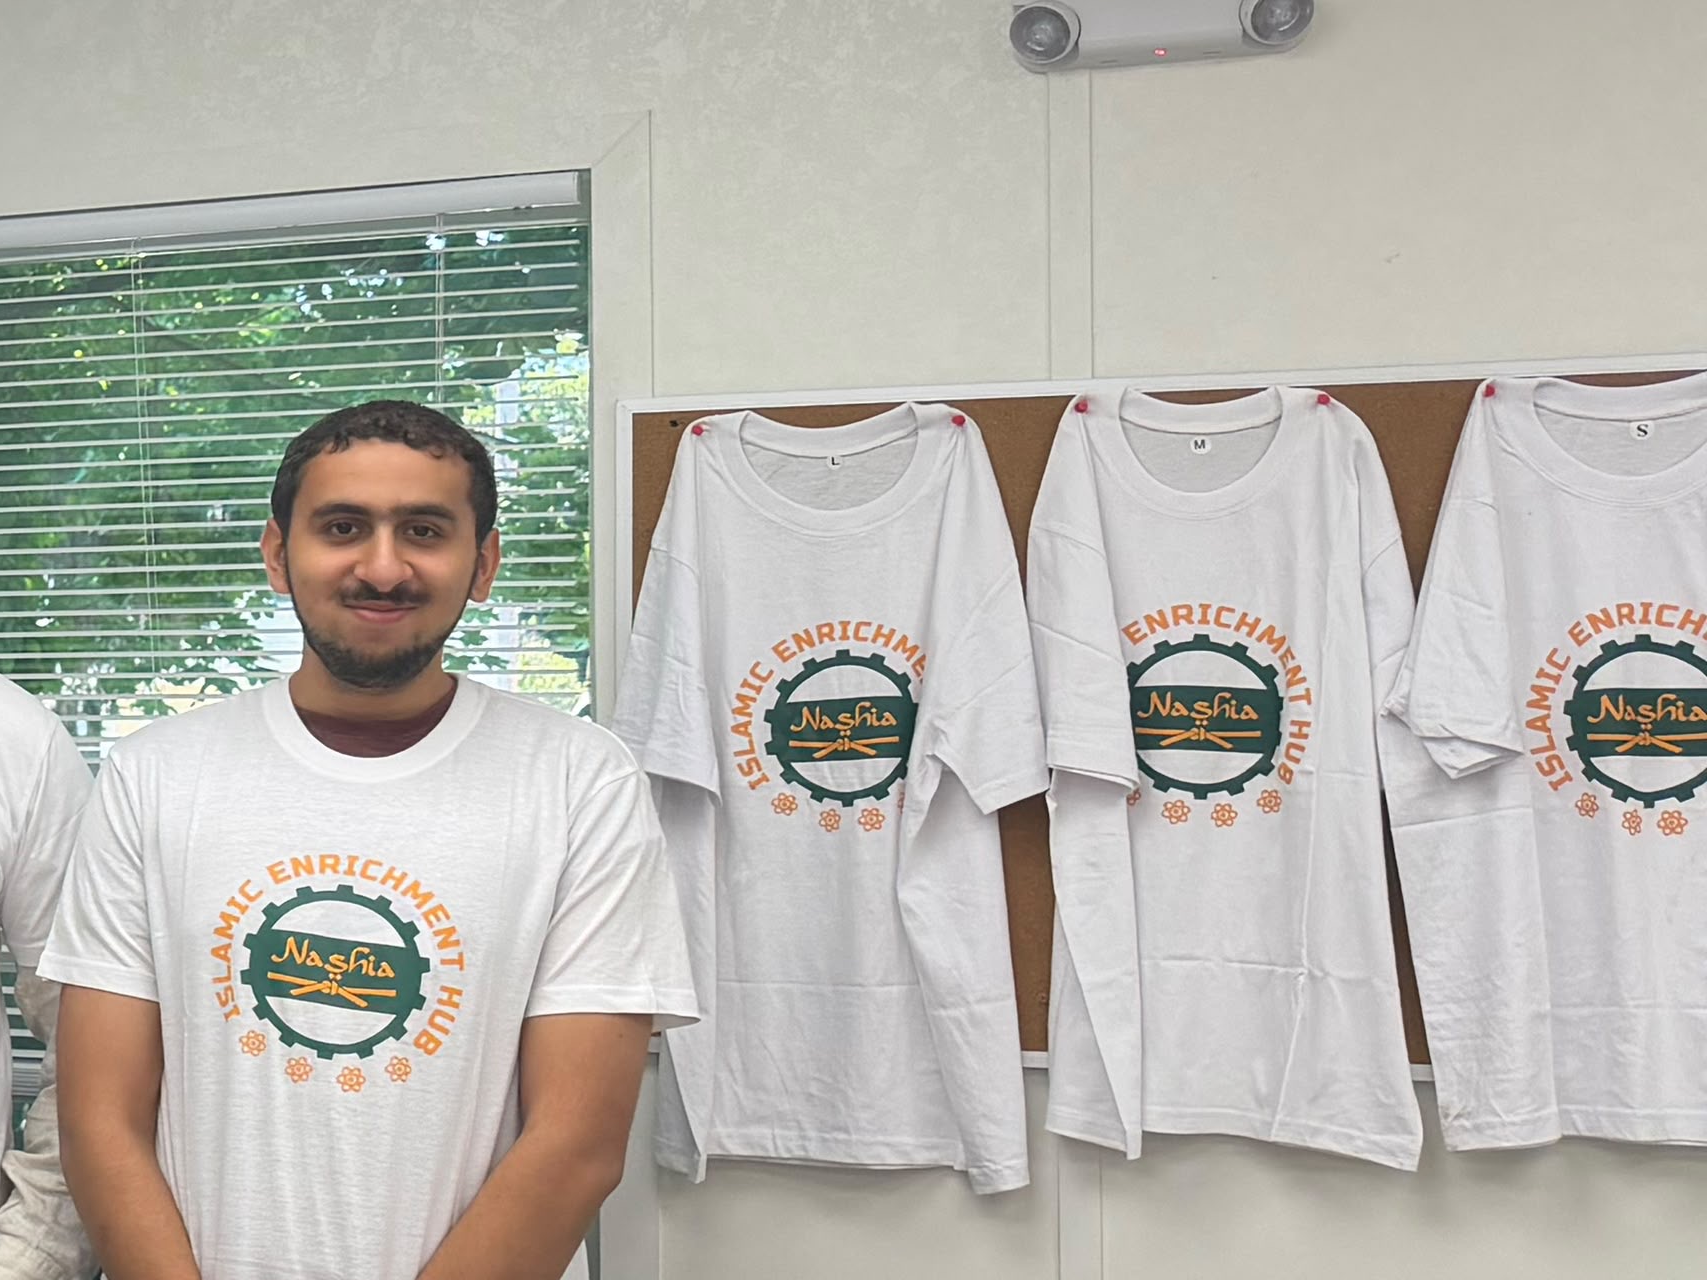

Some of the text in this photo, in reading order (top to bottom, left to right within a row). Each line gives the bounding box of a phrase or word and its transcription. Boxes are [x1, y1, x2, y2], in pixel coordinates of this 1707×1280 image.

[1194, 439, 1205, 450] M
[1637, 423, 1648, 437] S
[831, 456, 840, 465] L
[730, 620, 929, 790] ISLAMIC ENRICHME
[1121, 603, 1313, 785] ENRICHMENT HUB
[1137, 691, 1259, 720] Nashia
[1525, 602, 1707, 792] ISLAMIC ENRICH
[1587, 693, 1707, 724] Nashia
[790, 701, 897, 732] Nashia
[210, 853, 465, 1056] ISLAMIC ENRICHMENT HUB
[270, 936, 396, 978] Nashia
